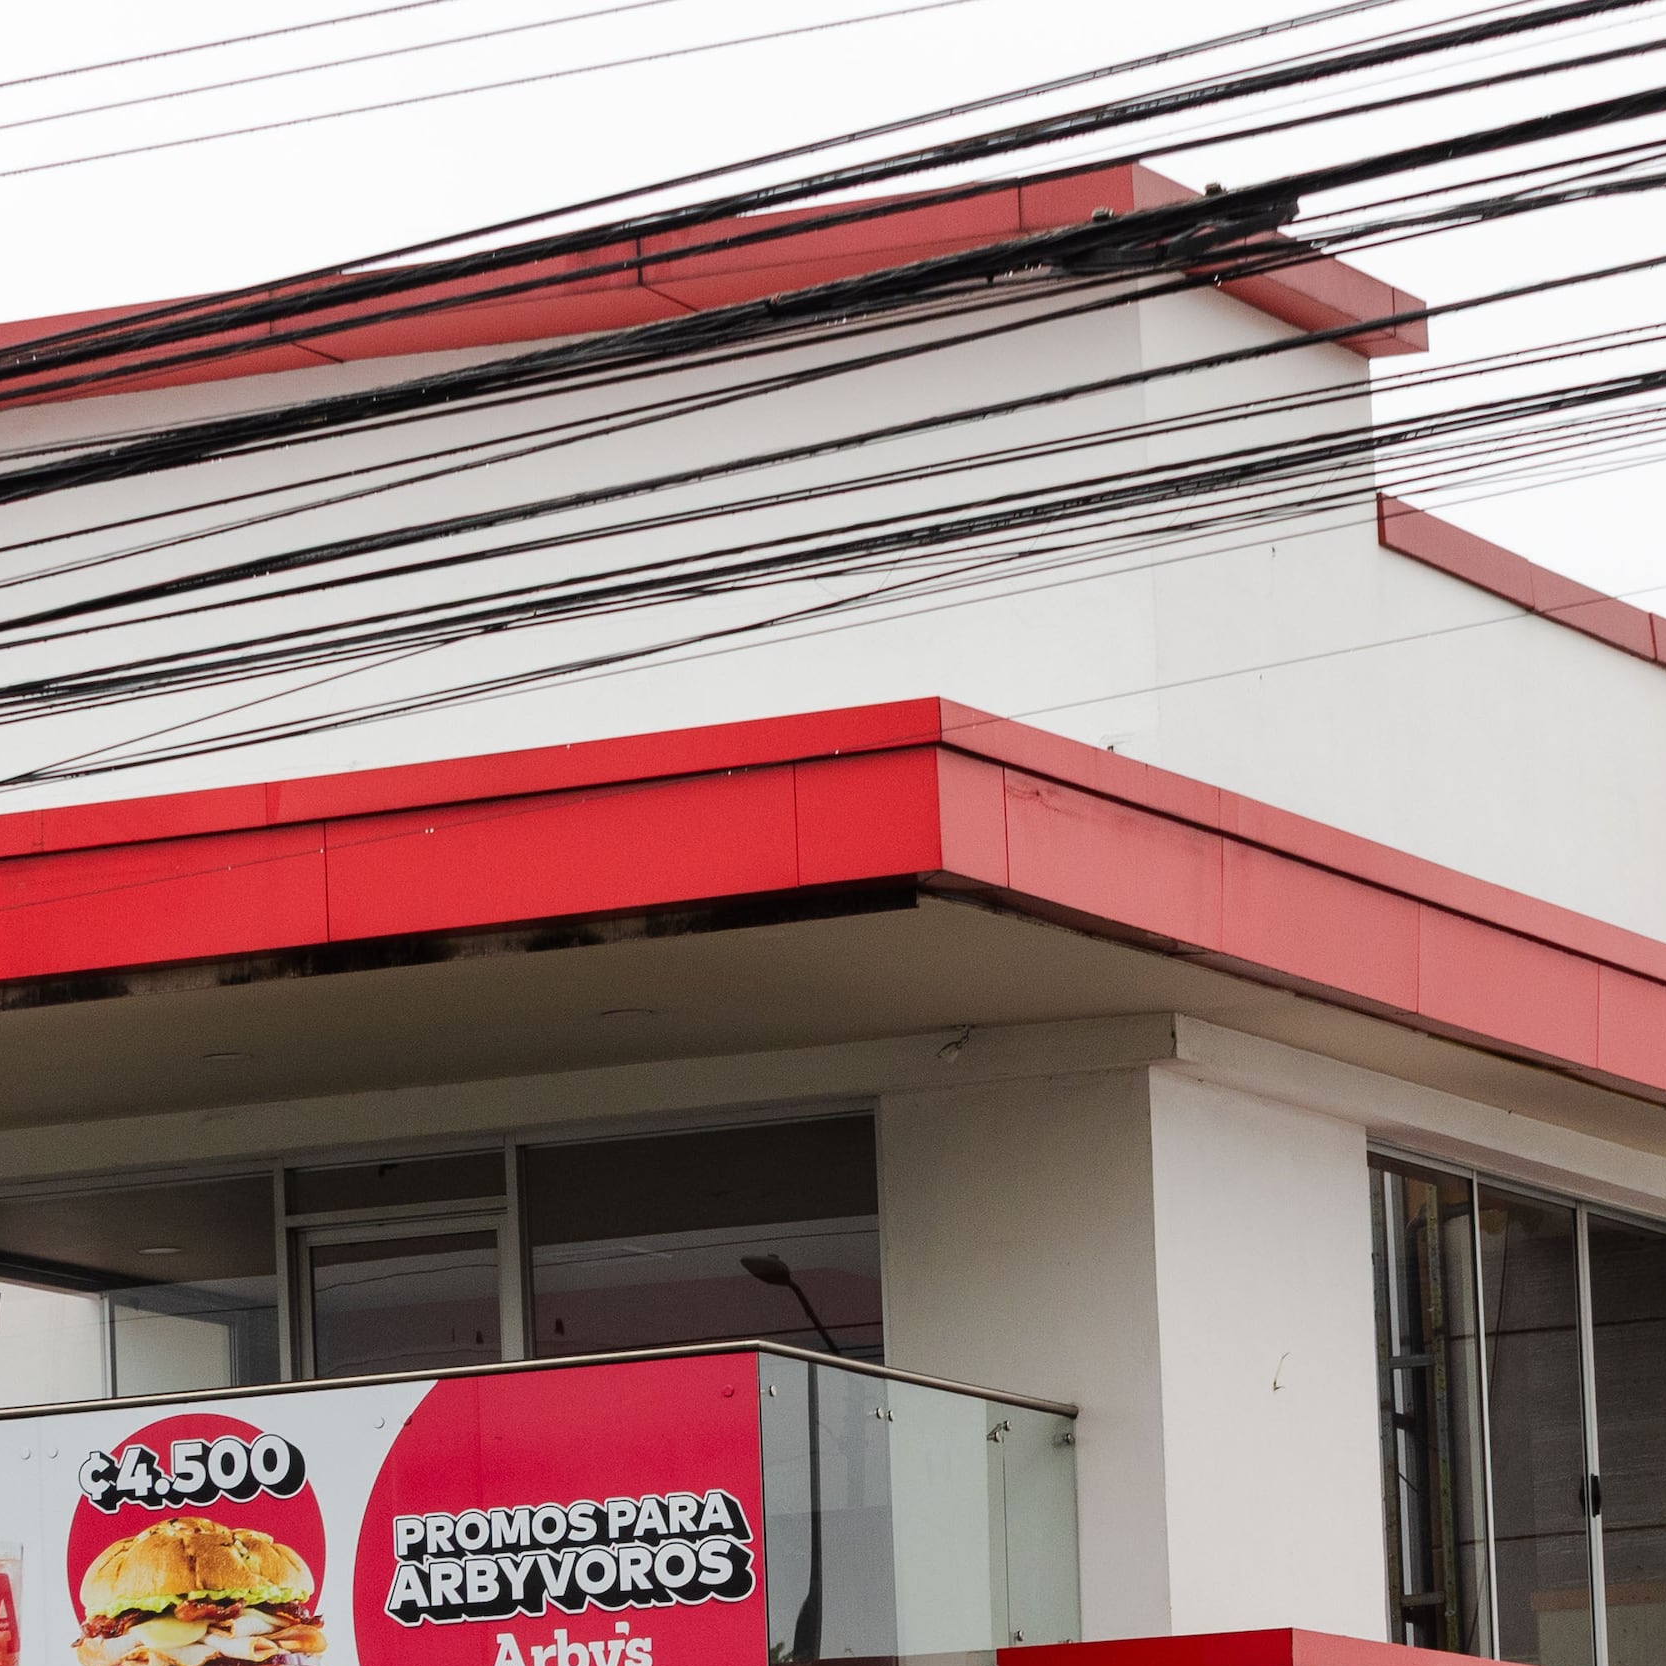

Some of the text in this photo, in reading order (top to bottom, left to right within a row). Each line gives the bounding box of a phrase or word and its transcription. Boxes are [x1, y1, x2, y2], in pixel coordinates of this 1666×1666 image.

[396, 1492, 741, 1556] PROMOS PARA
[386, 1539, 744, 1616] ARBYVOROS
